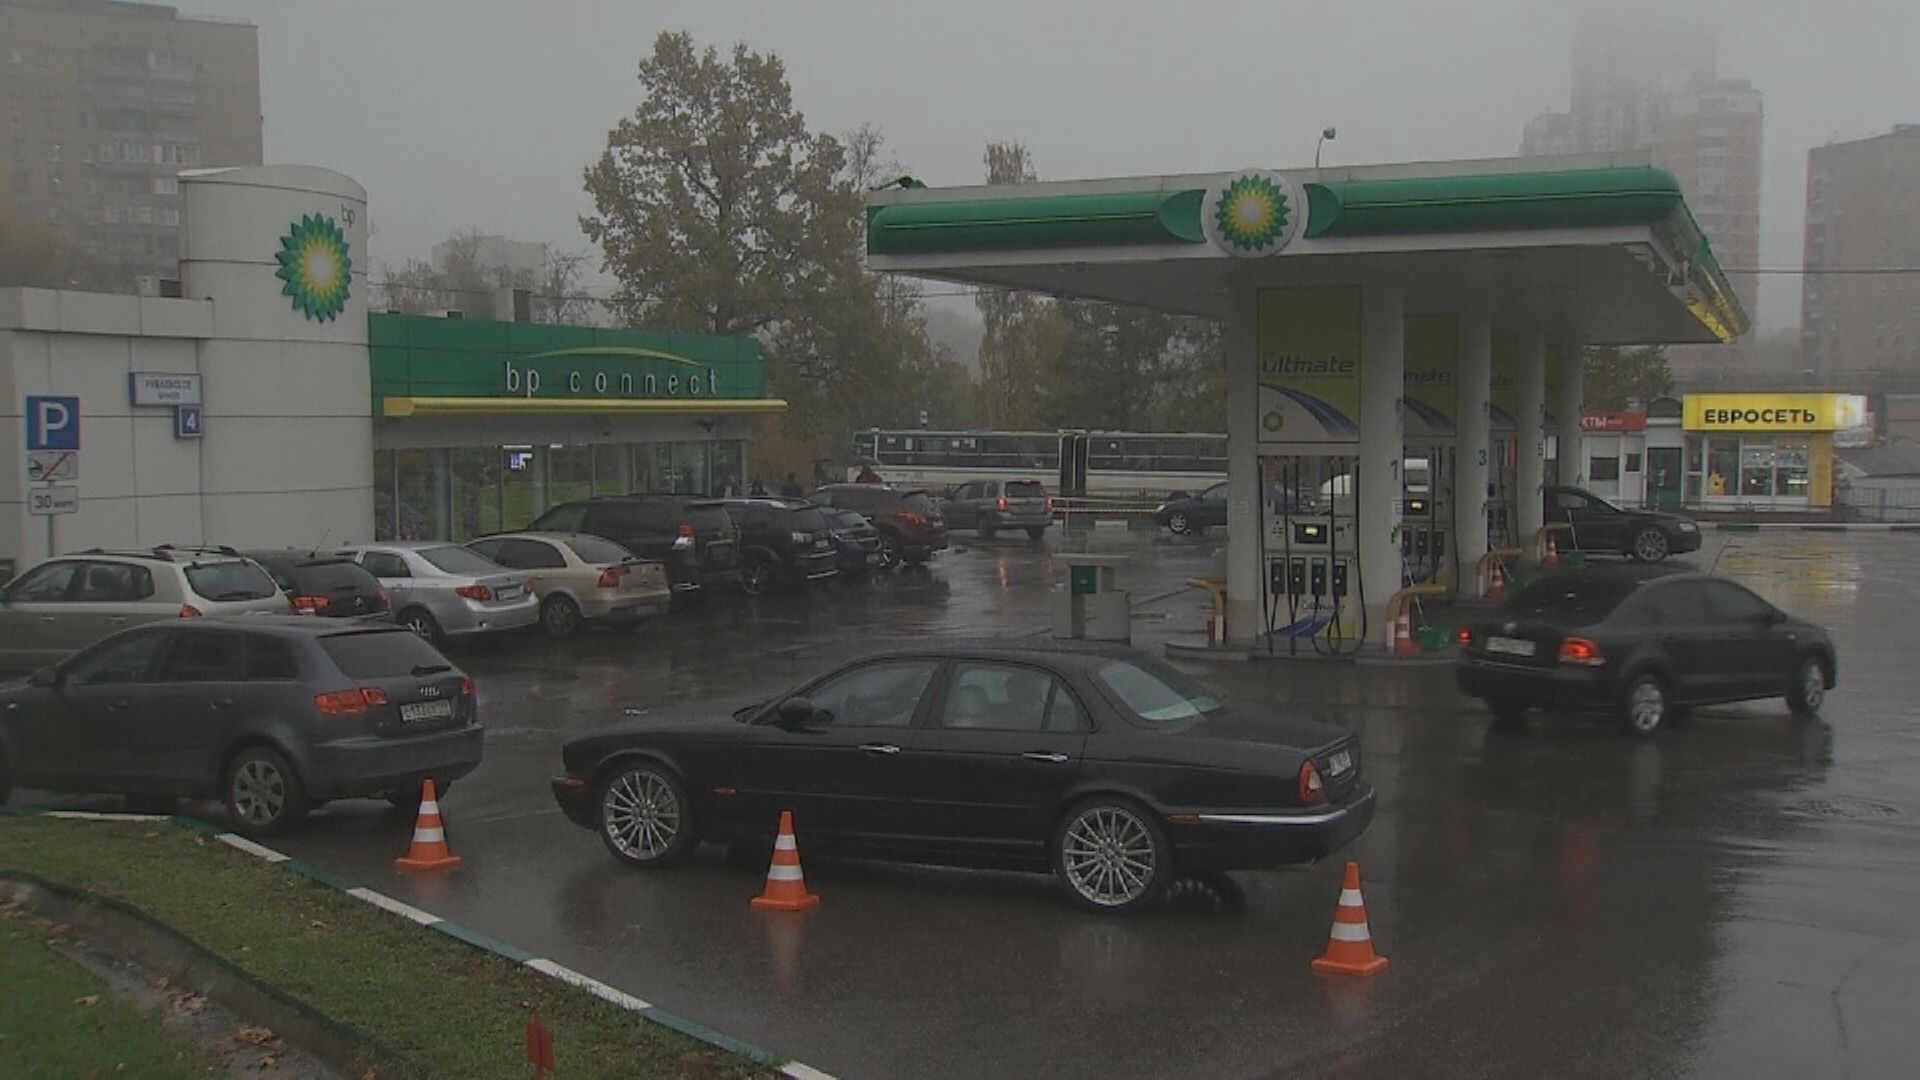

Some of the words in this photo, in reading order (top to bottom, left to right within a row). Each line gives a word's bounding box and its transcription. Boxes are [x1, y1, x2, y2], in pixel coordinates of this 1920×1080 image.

[341, 203, 356, 228] bp
[505, 361, 541, 397] bp
[569, 367, 717, 394] connect
[40, 402, 69, 445] P
[186, 413, 197, 429] 4
[1705, 409, 1815, 425] ЕВРОСЕТЬ
[1478, 449, 1487, 466] 3
[1390, 460, 1398, 481] 1
[34, 495, 52, 509] 30
